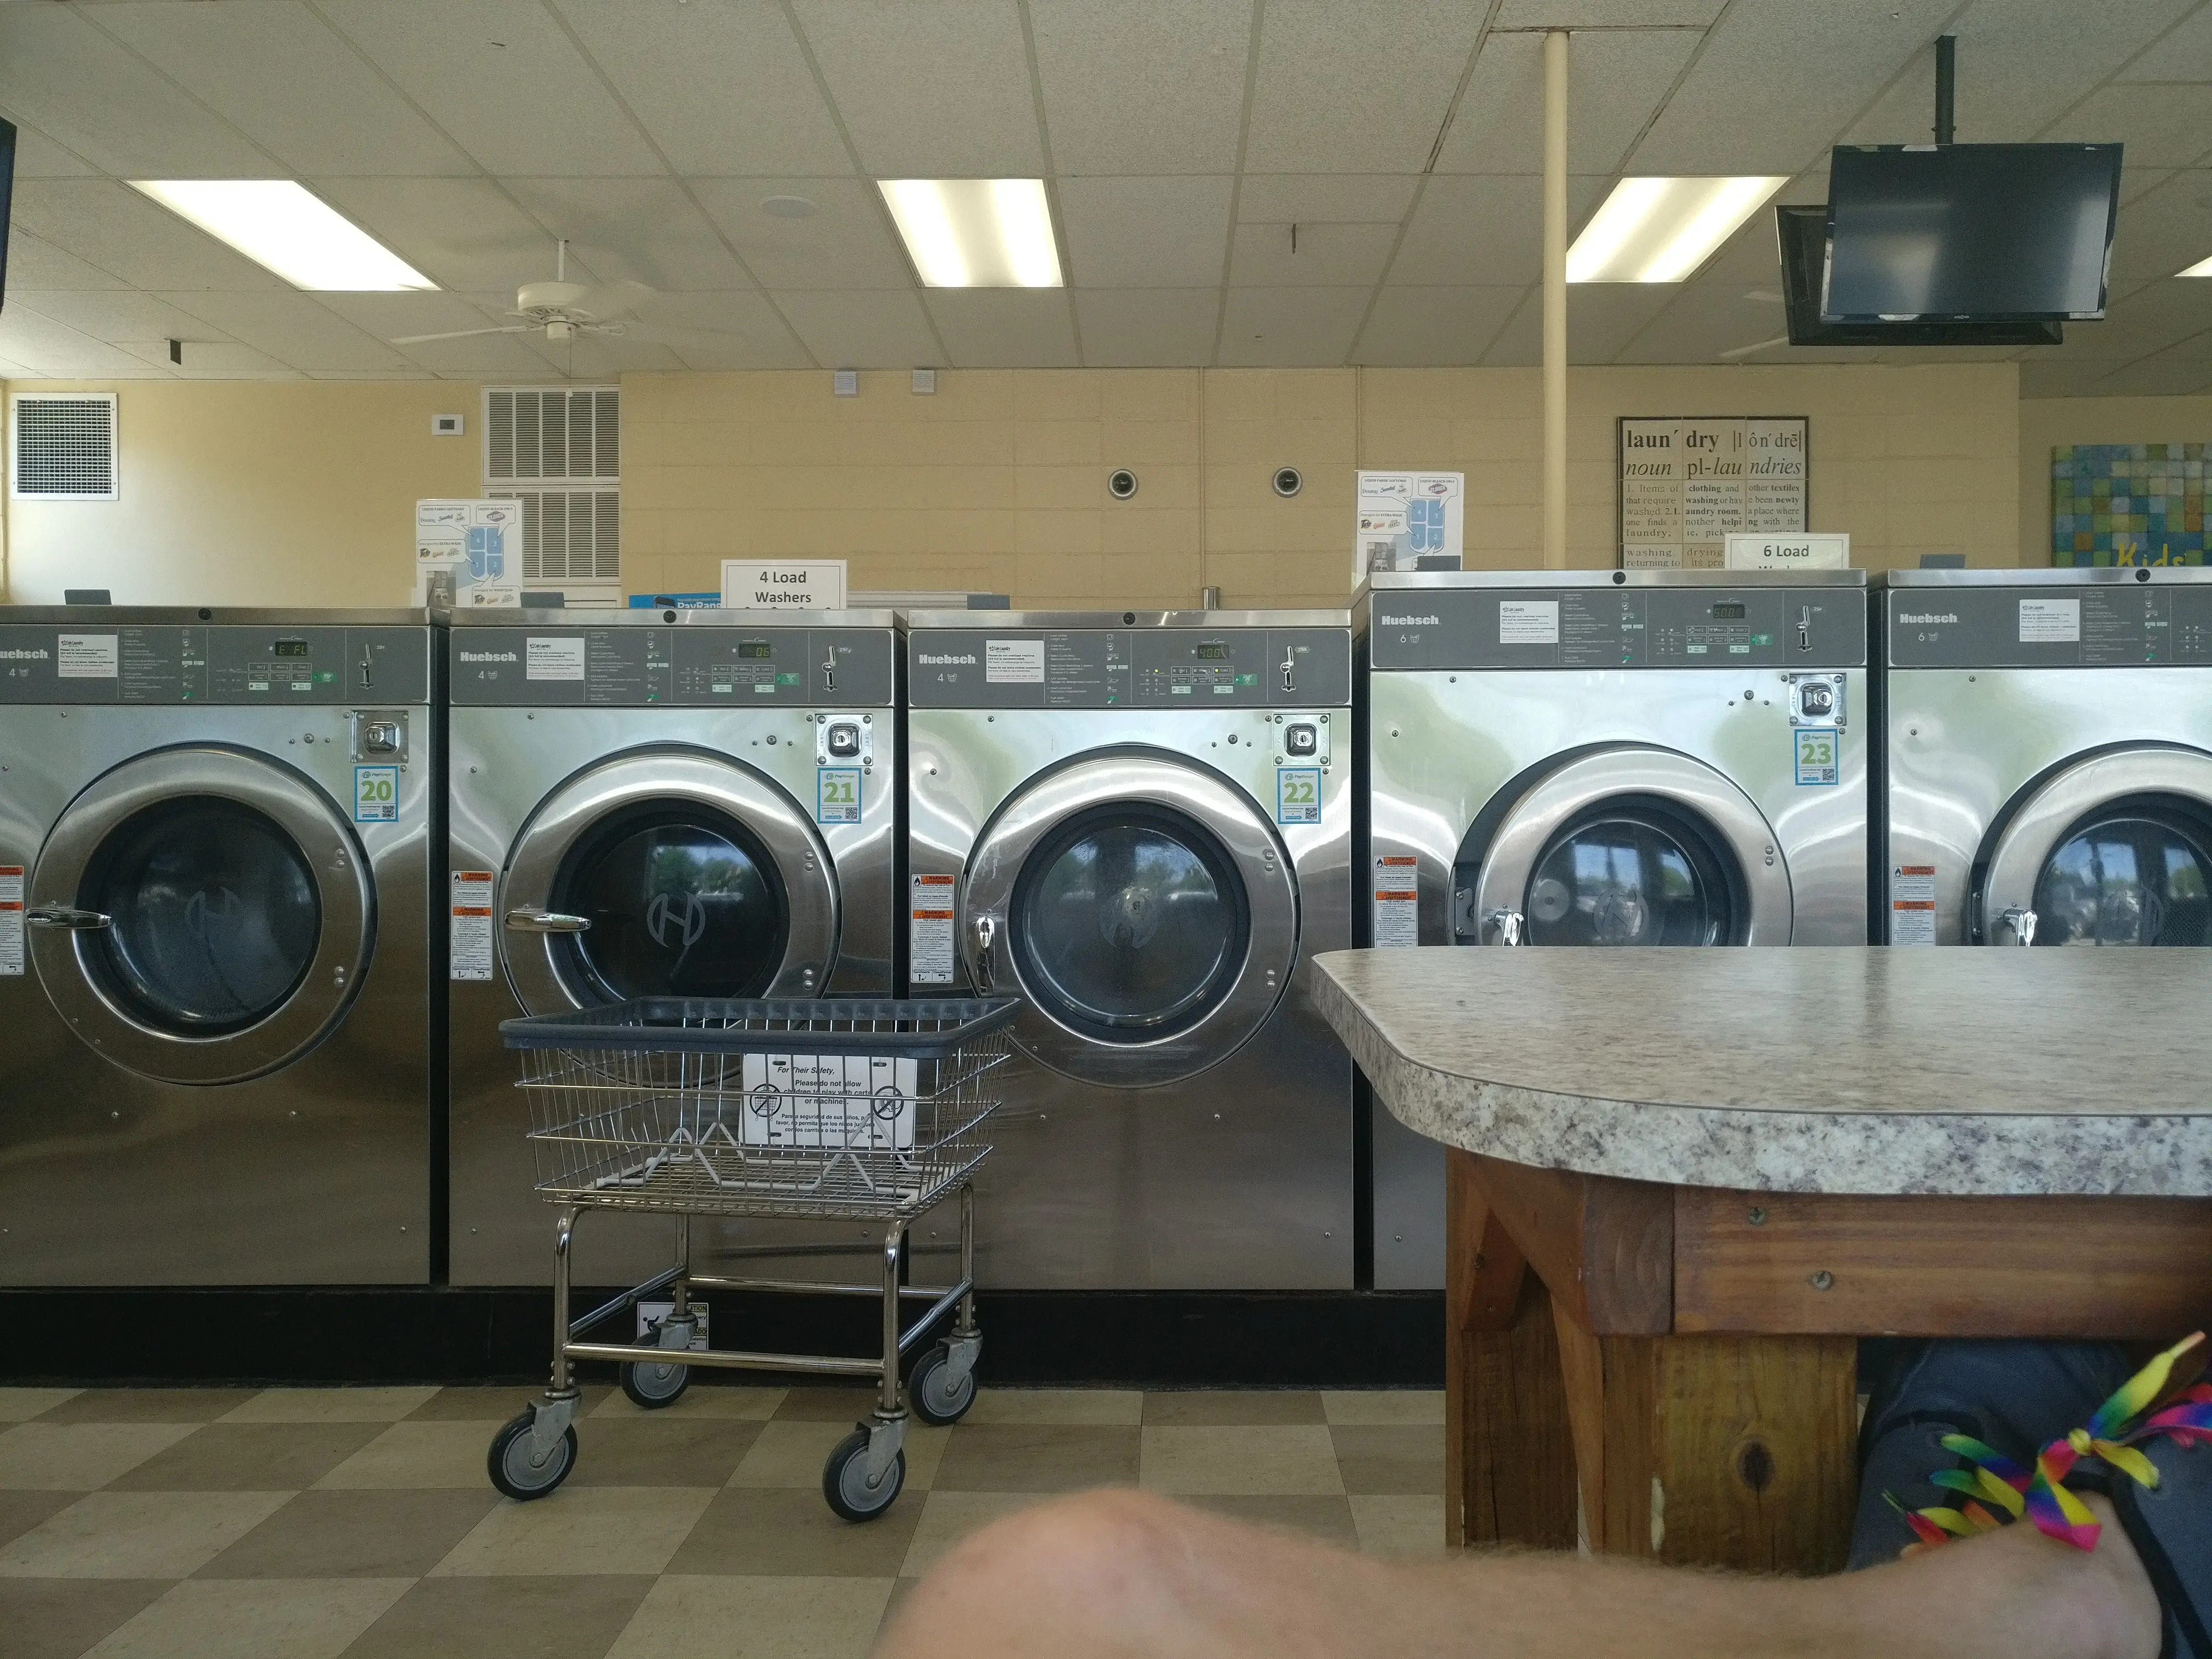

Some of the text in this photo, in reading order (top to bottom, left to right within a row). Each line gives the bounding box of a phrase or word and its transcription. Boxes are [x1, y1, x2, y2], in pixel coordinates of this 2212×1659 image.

[1626, 462, 1671, 476] noun
[1627, 484, 1634, 492] 1.
[1640, 484, 1665, 492] Items
[1669, 484, 1679, 492] of
[1689, 484, 1721, 494] clothing
[1643, 497, 1676, 505] require
[1685, 496, 1719, 505] washing
[1776, 496, 1799, 505] newly
[1754, 507, 1773, 516] place
[1648, 518, 1667, 526] finds
[1764, 545, 1809, 557] 6 Load
[1626, 558, 1669, 567] returning
[760, 571, 806, 583] 4 Load
[755, 591, 811, 603] Washers
[1382, 615, 1439, 625] Huebsch
[1899, 613, 1957, 624] Huebsch
[1400, 634, 1406, 644] 6
[1918, 632, 1925, 642] 6
[0, 649, 48, 659] uebsch
[460, 651, 517, 662] Huebsch
[919, 654, 976, 664] Huebsch
[9, 668, 16, 677] 4
[478, 671, 484, 679] 4
[937, 673, 944, 682] 4
[1801, 743, 1831, 764] 23
[361, 780, 392, 801] 20
[824, 782, 855, 802] 21
[1283, 782, 1314, 803] 22
